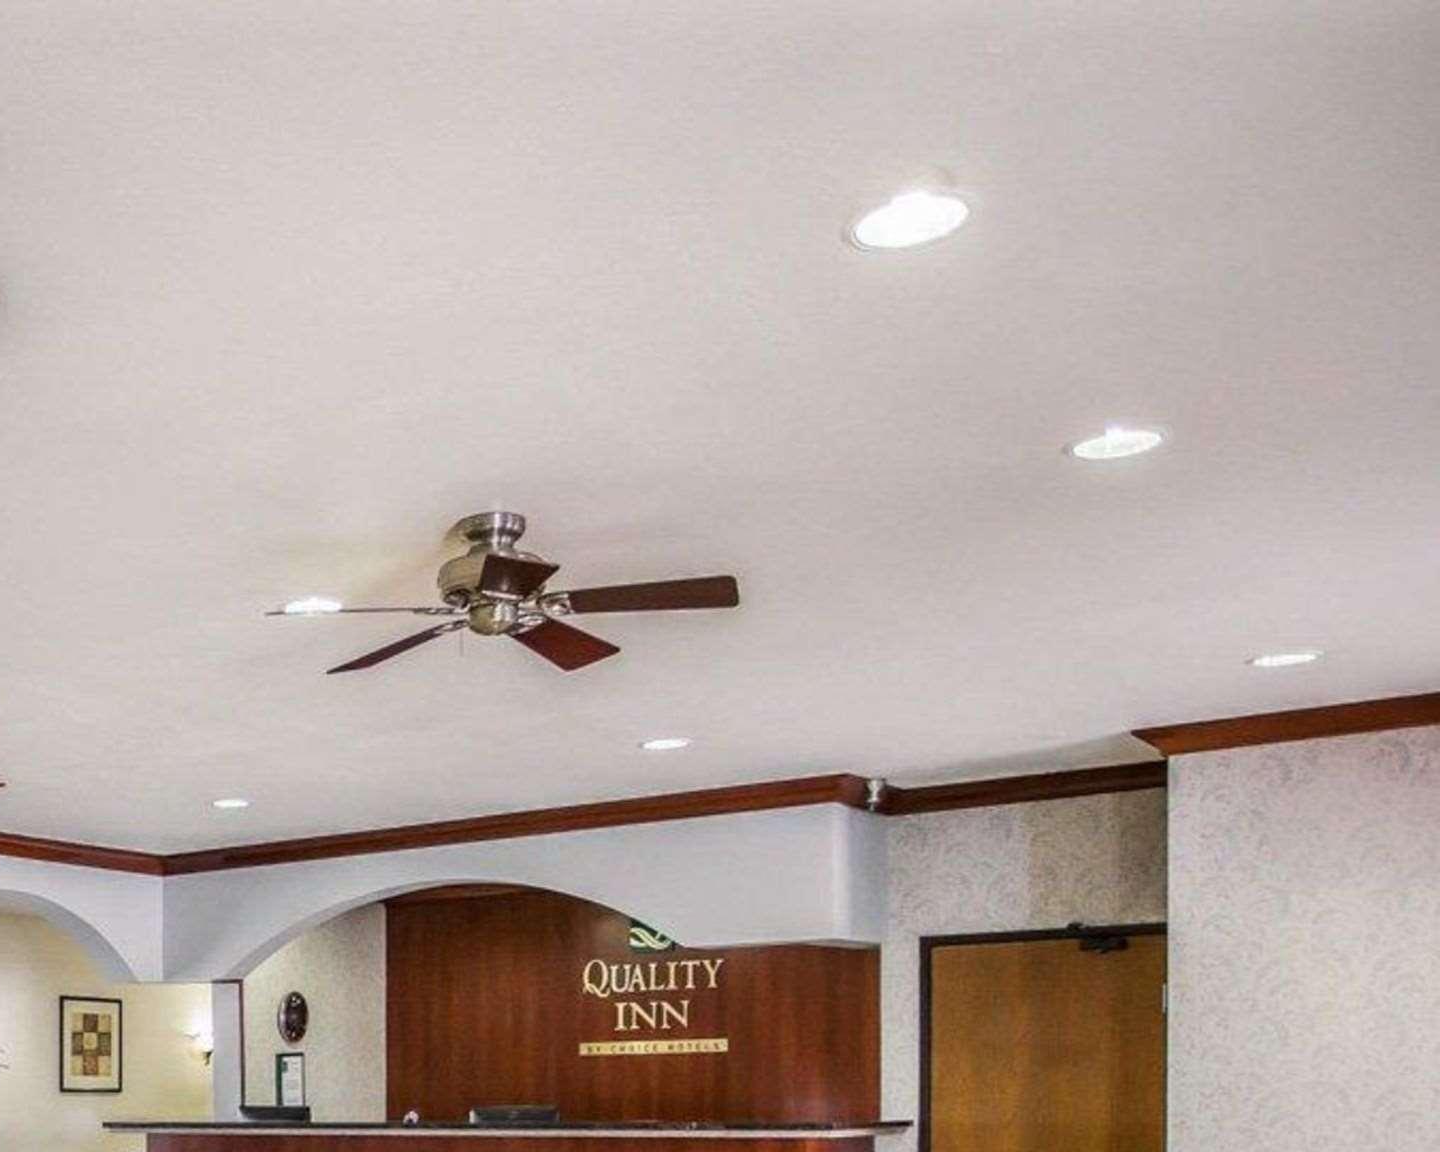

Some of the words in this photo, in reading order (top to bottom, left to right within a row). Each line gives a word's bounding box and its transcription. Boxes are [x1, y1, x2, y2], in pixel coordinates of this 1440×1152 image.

[583, 959, 724, 998] QUALITY
[614, 1000, 690, 1031] INN
[611, 1043, 659, 1053] CHOICE
